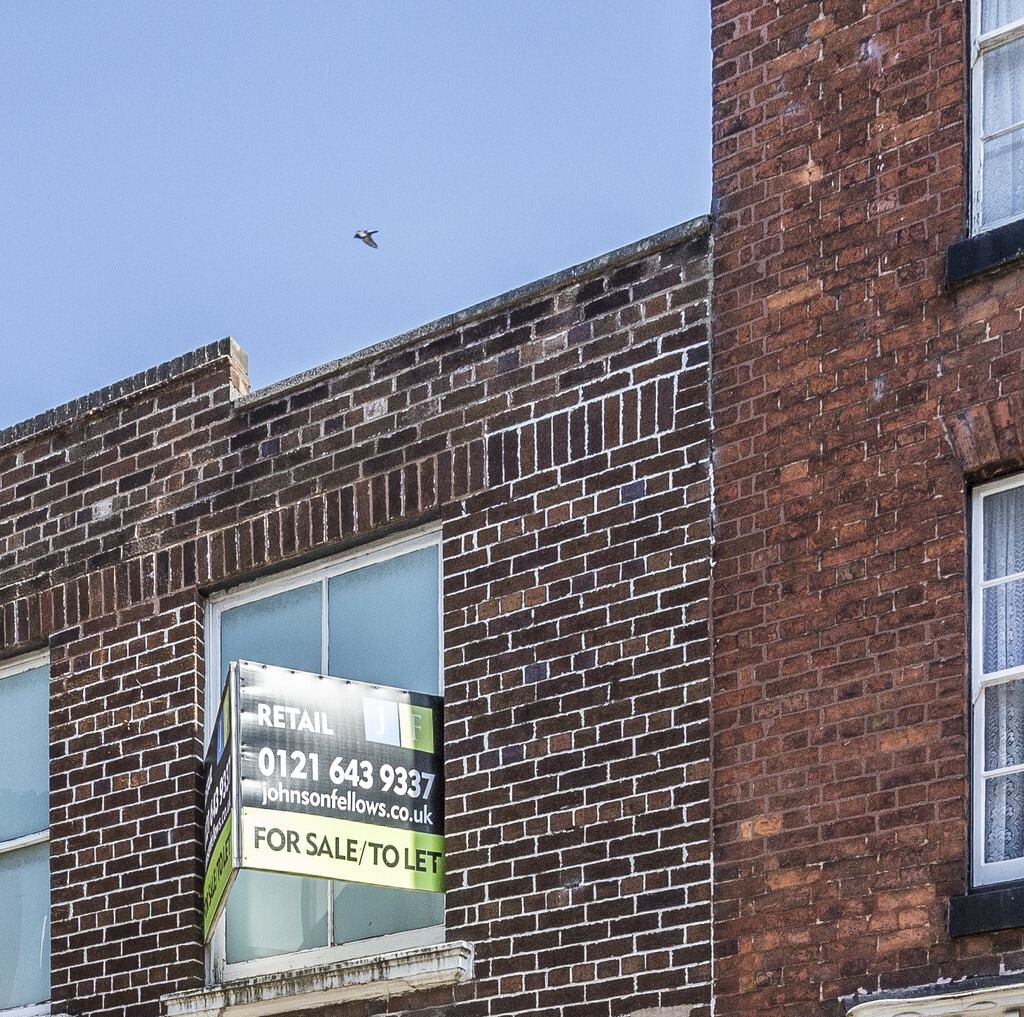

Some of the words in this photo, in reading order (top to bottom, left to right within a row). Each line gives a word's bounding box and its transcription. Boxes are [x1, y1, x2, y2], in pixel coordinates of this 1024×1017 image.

[257, 703, 334, 735] RETAIL
[258, 747, 319, 780] 0121
[329, 757, 373, 790] 643
[380, 764, 435, 799] 9337
[261, 782, 433, 825] johnsonfellows.co.uk
[254, 827, 300, 855] FOR
[405, 849, 442, 874] LET
